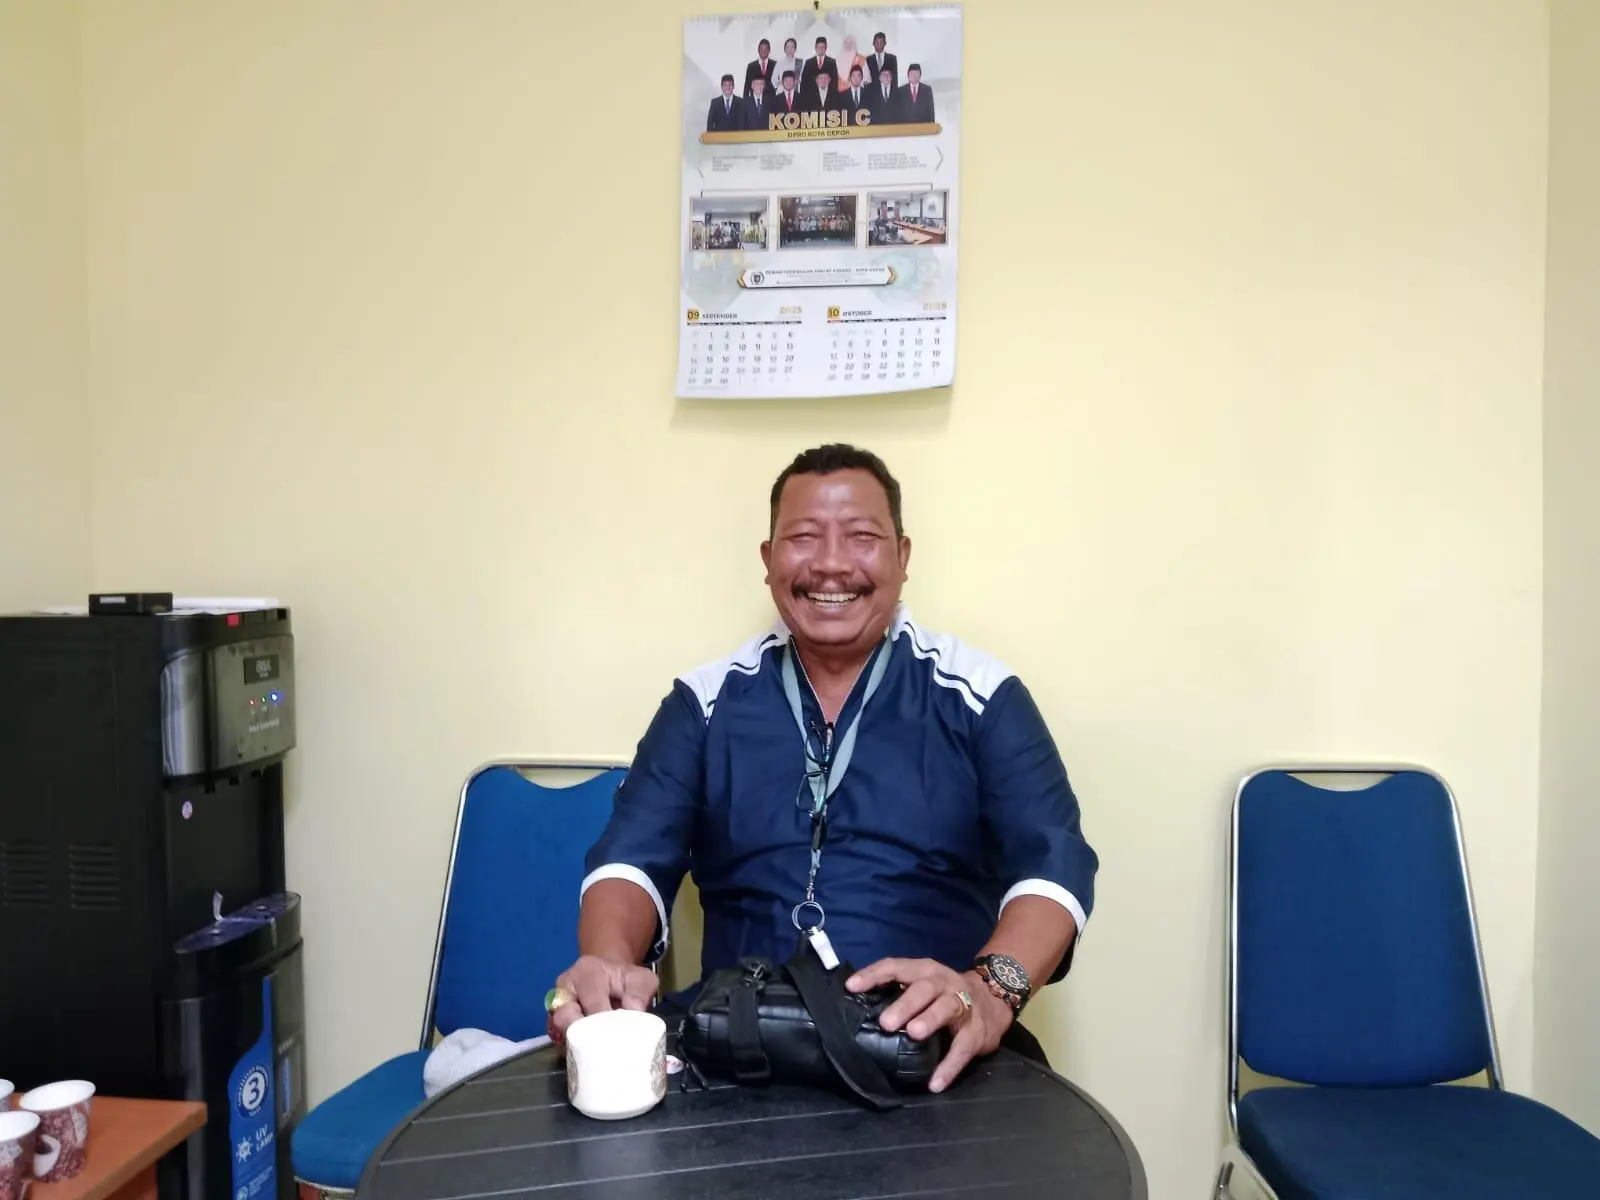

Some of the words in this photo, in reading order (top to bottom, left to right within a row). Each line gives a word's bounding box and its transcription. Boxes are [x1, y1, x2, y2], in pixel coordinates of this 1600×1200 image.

[768, 109, 848, 131] KOMISI
[855, 108, 871, 126] C
[687, 311, 699, 320] 09
[828, 308, 839, 317] 10
[248, 1077, 260, 1105] 3
[256, 1124, 268, 1140] UV
[256, 1132, 274, 1152] LAMP
